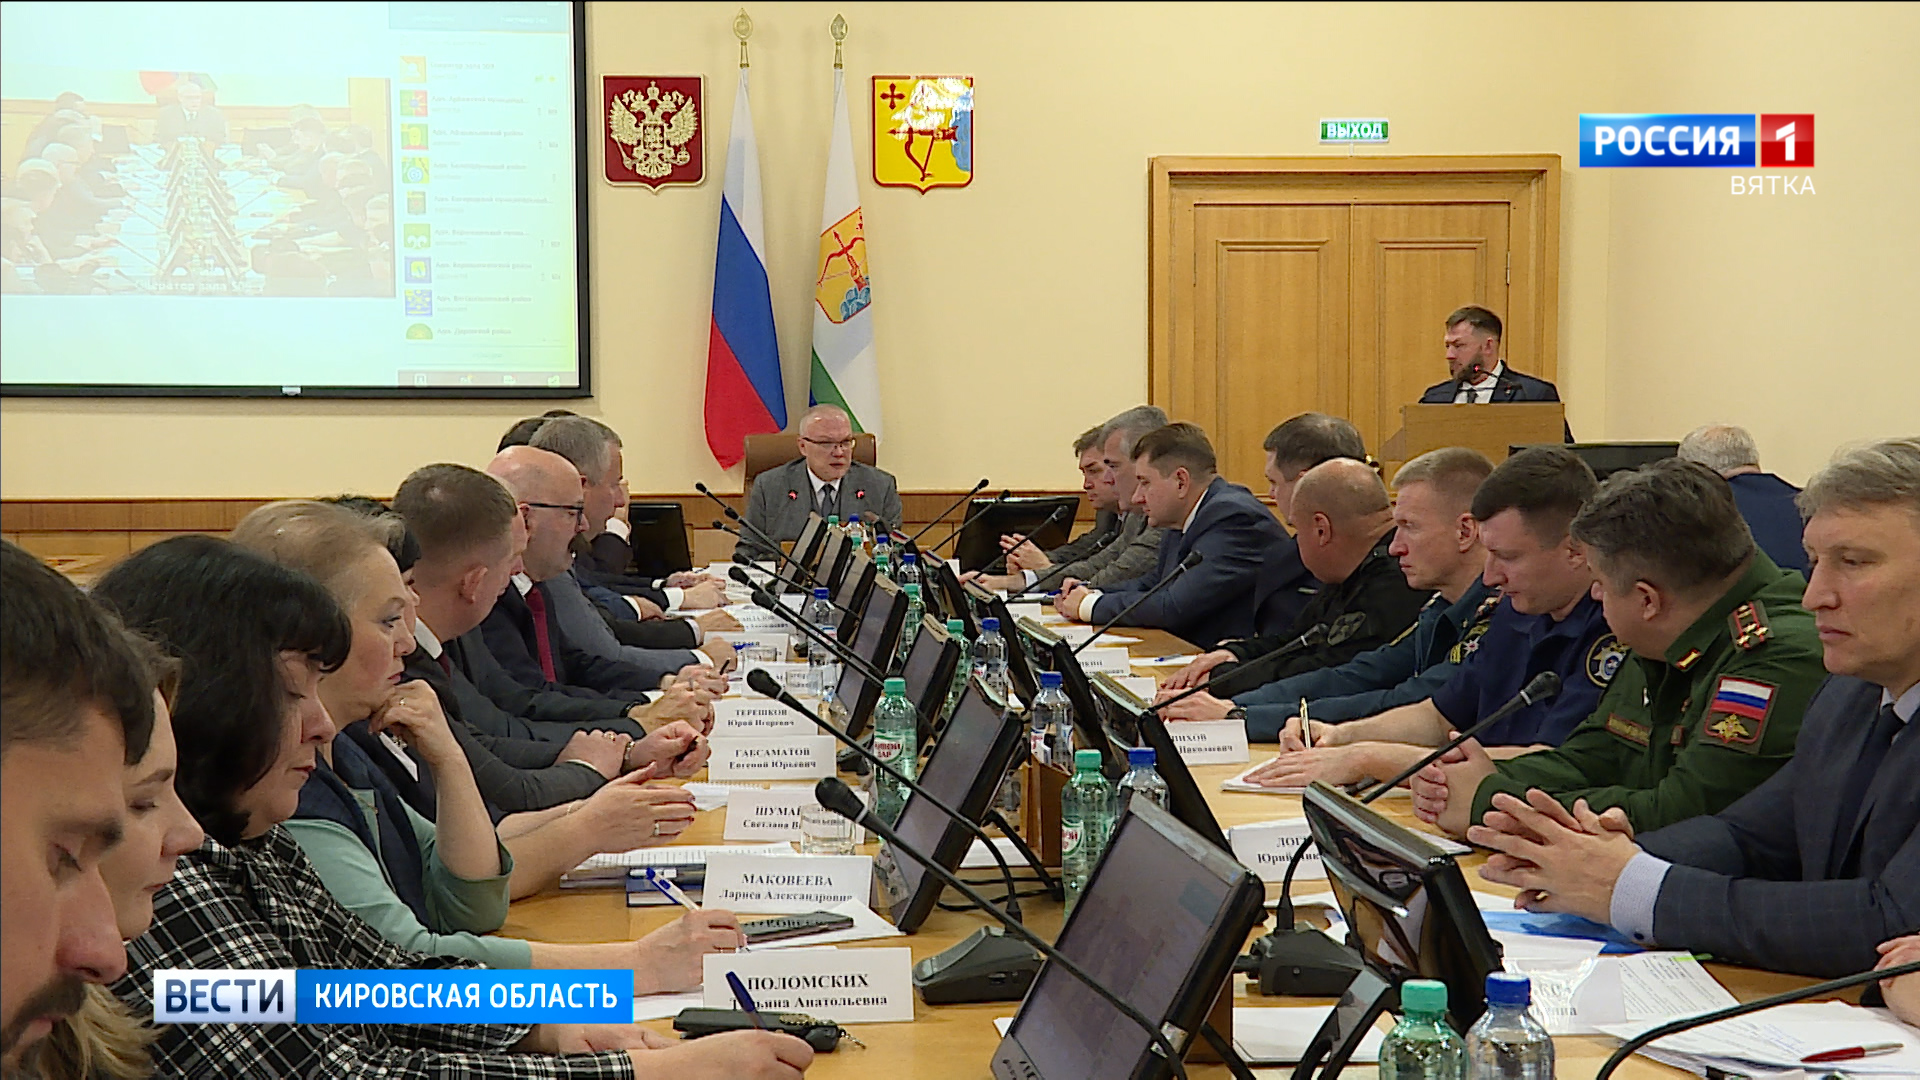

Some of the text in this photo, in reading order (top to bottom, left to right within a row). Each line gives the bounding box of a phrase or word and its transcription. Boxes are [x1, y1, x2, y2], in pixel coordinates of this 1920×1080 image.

[1326, 122, 1384, 139] ВЫХОД
[729, 760, 817, 770] Евгений Юрьевич
[743, 819, 789, 830] Светлана
[741, 873, 833, 887] МАКОВЕЕВА
[719, 889, 761, 900] Лариса
[747, 973, 869, 991] ПОЛОМСКИХ
[794, 995, 888, 1009] Анатольевна
